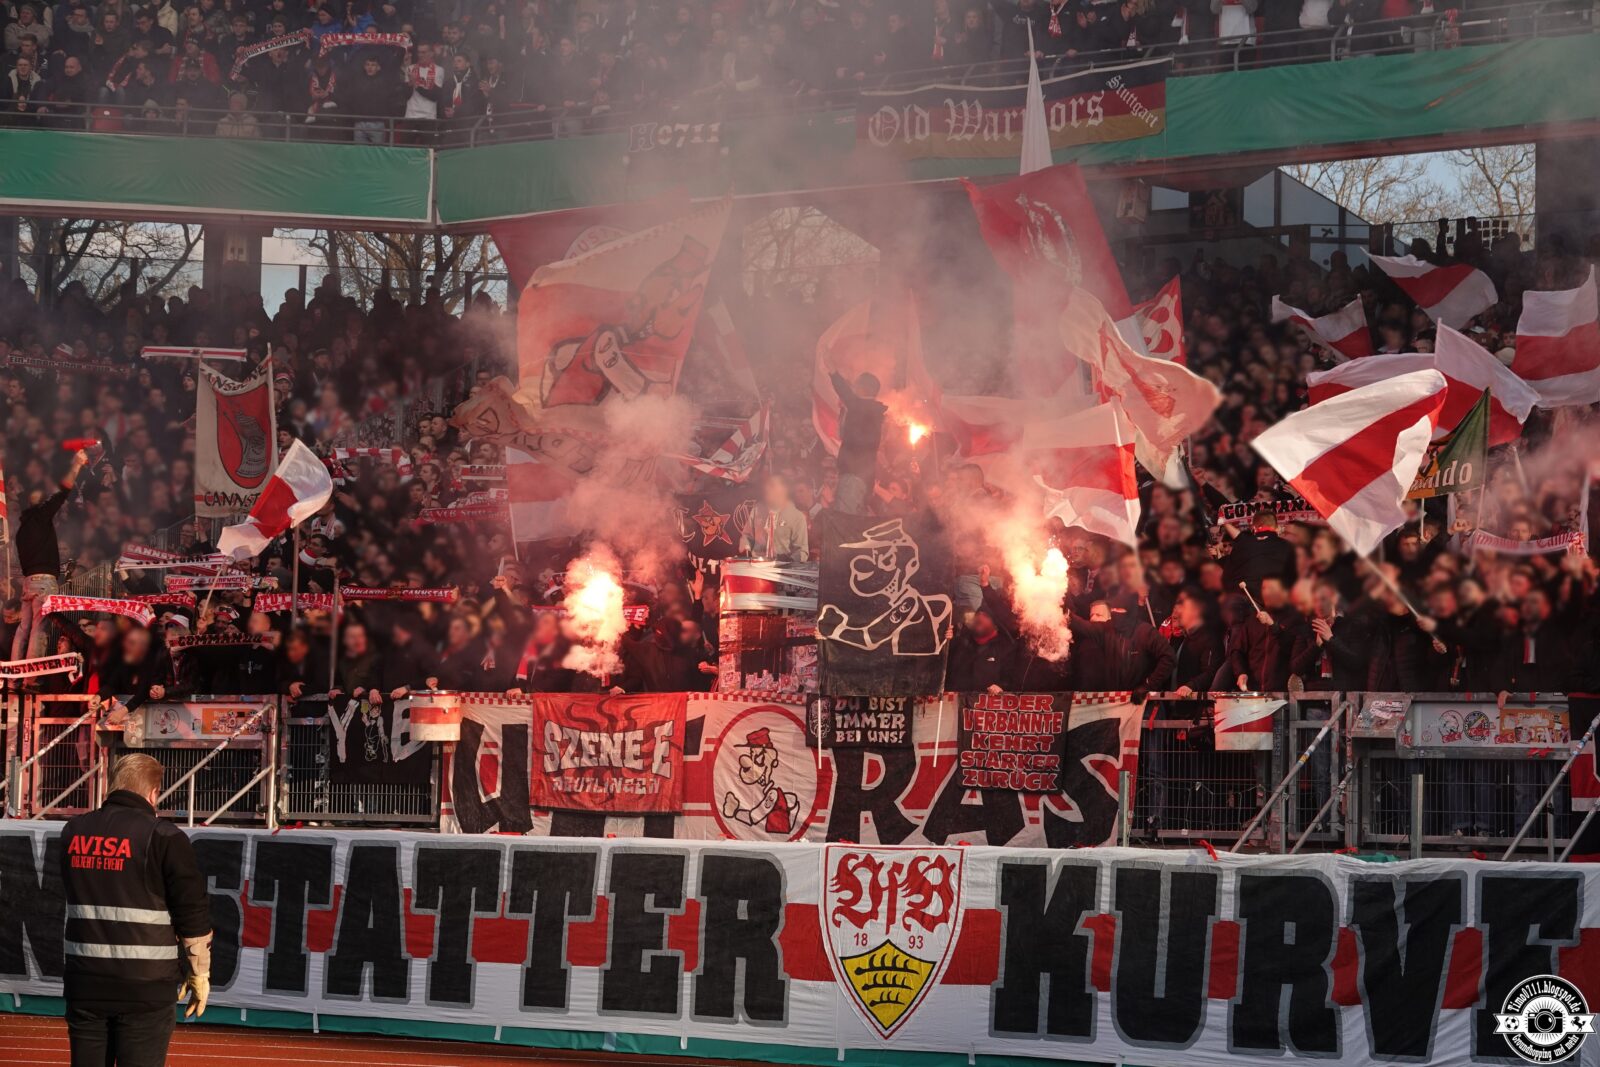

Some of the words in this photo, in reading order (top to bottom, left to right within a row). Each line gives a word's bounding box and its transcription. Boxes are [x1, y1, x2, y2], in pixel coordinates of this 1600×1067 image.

[1106, 74, 1159, 129] Stuttgart
[868, 102, 931, 147] Old
[943, 89, 1106, 143] Warors
[835, 697, 860, 711] DU
[868, 697, 908, 711] BIST
[973, 693, 1055, 712] JEDER
[835, 712, 906, 730] IMMER
[963, 707, 1064, 734] VERBANNTE
[543, 719, 645, 773] SZENE
[835, 730, 861, 743] BEI
[867, 730, 907, 744] UNS!
[971, 732, 1055, 752] KEHRT
[962, 768, 1058, 791] ZURÜCK
[67, 834, 132, 859] AVISA
[103, 857, 125, 872] EVENT
[829, 852, 957, 936] VfB
[853, 932, 869, 947] 18
[908, 935, 924, 950] 93
